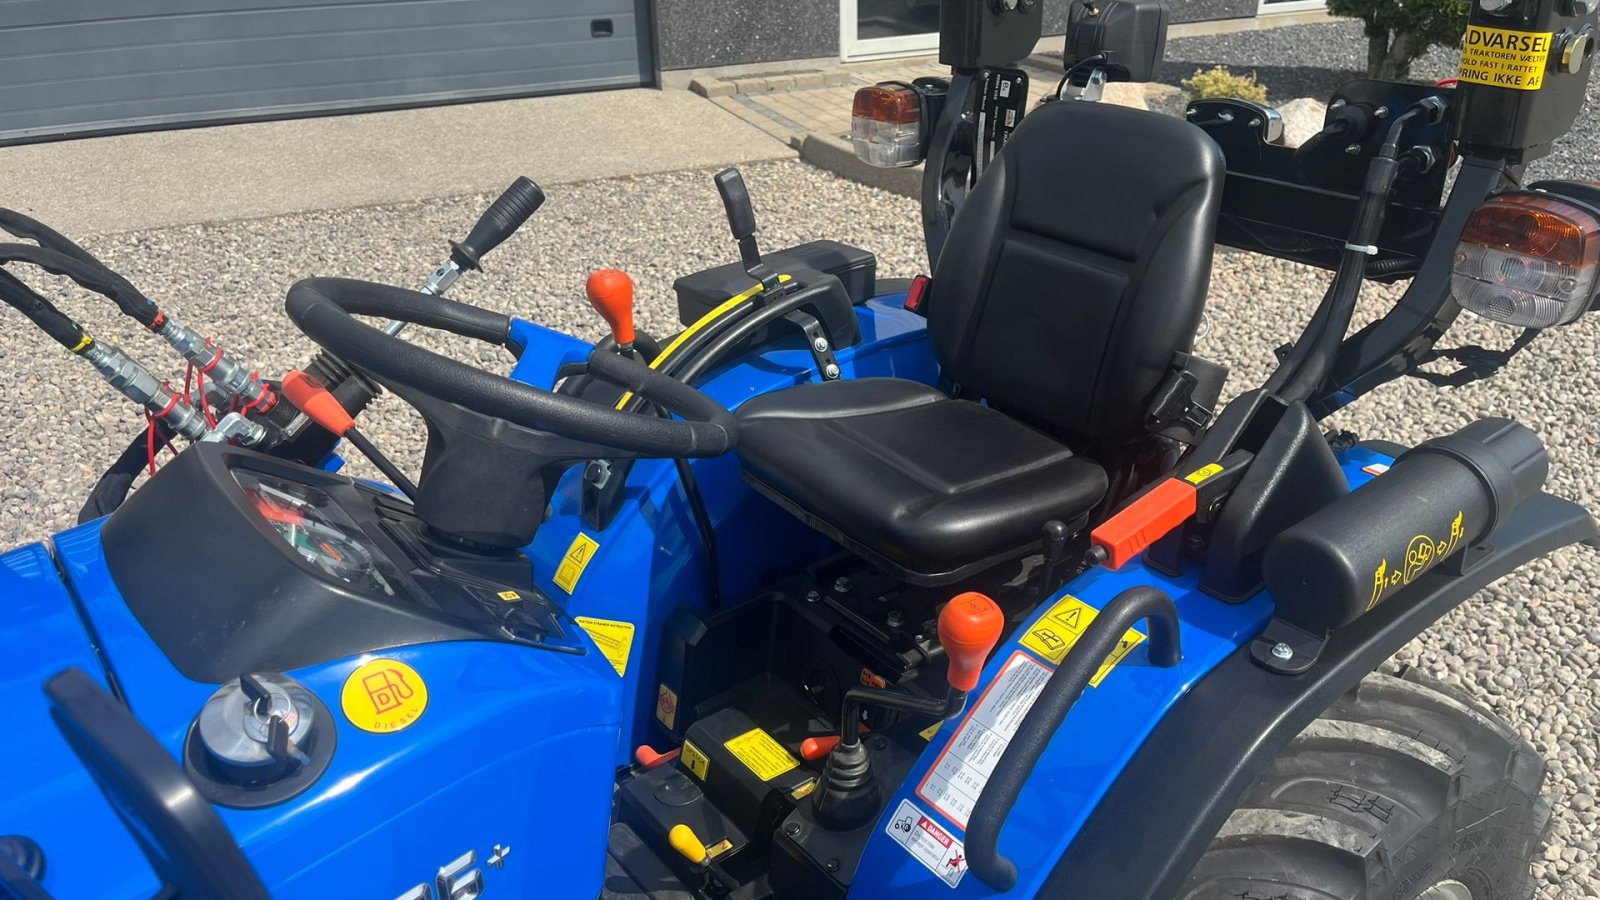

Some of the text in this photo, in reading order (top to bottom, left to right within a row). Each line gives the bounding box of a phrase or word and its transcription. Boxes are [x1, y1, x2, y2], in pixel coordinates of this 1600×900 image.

[1470, 48, 1516, 60] TRAKTOREN
[1462, 58, 1477, 66] OLD
[1480, 60, 1499, 69] FAST
[1507, 63, 1537, 73] RATTET
[1493, 73, 1522, 85] IKKE
[374, 708, 419, 730] DIESEL
[927, 824, 949, 847] DANGER
